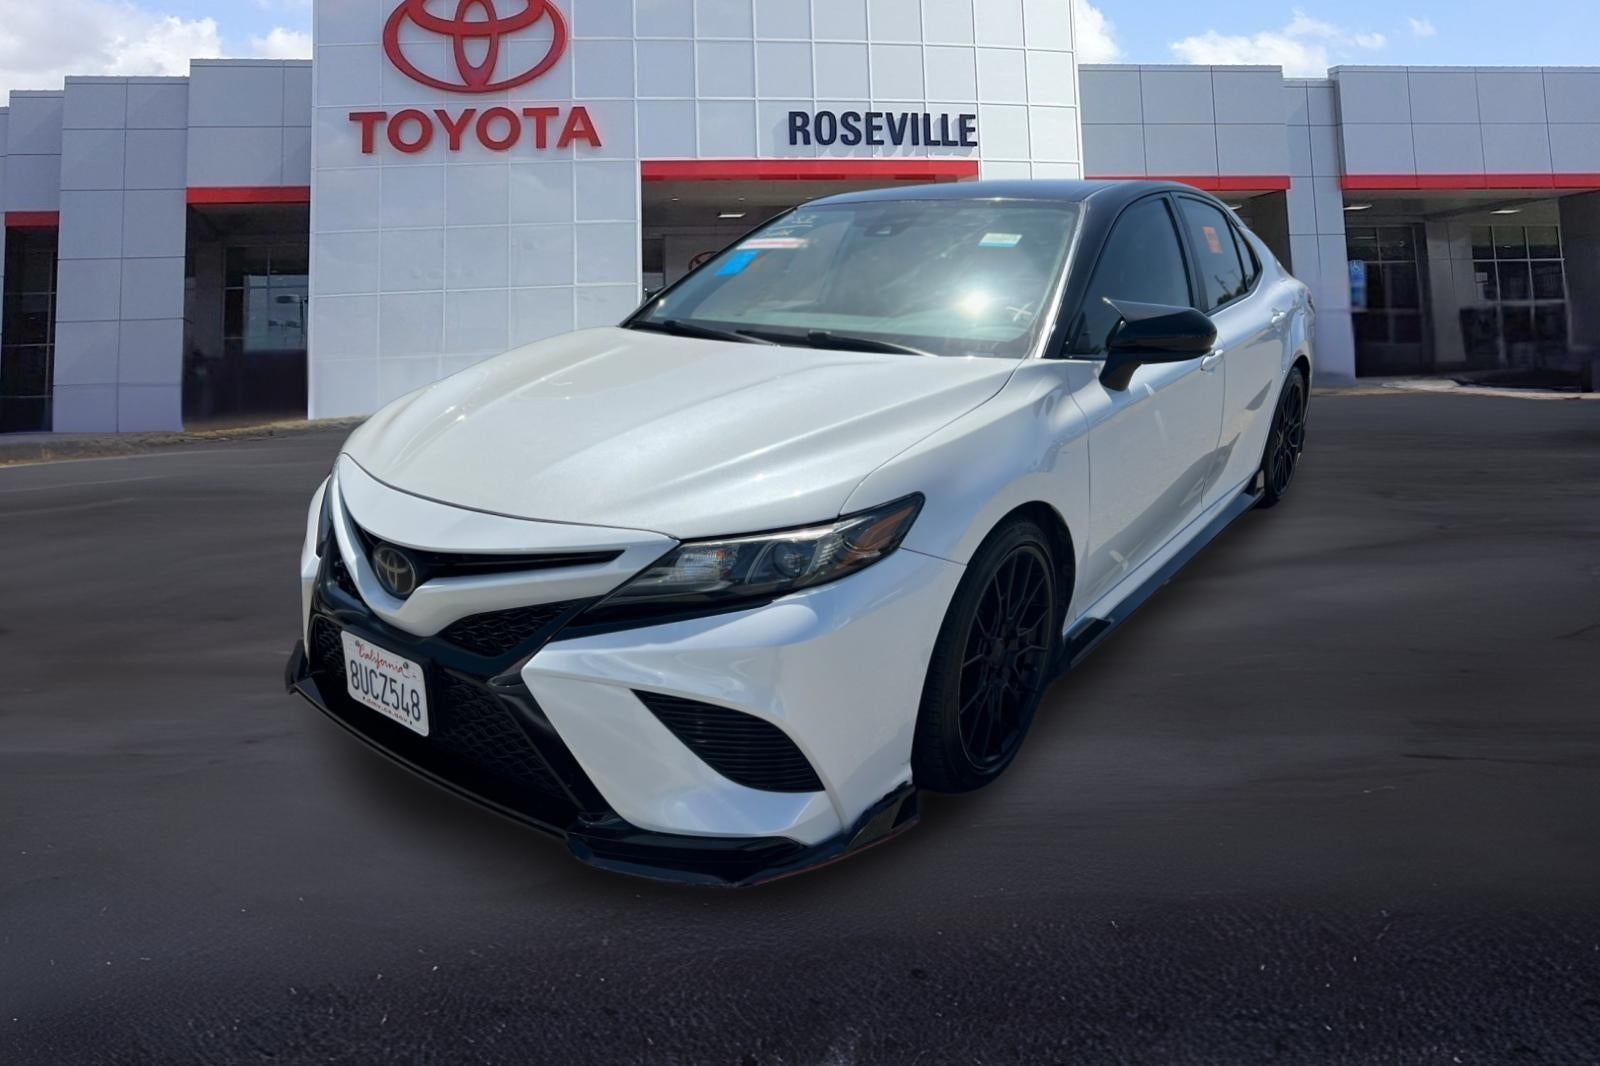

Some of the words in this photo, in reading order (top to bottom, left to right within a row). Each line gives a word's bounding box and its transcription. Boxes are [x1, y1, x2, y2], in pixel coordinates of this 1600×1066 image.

[349, 106, 602, 154] TOYOTA
[788, 111, 978, 147] ROSEVILLE
[358, 643, 405, 673] California
[350, 659, 421, 722] 8UCZ548
